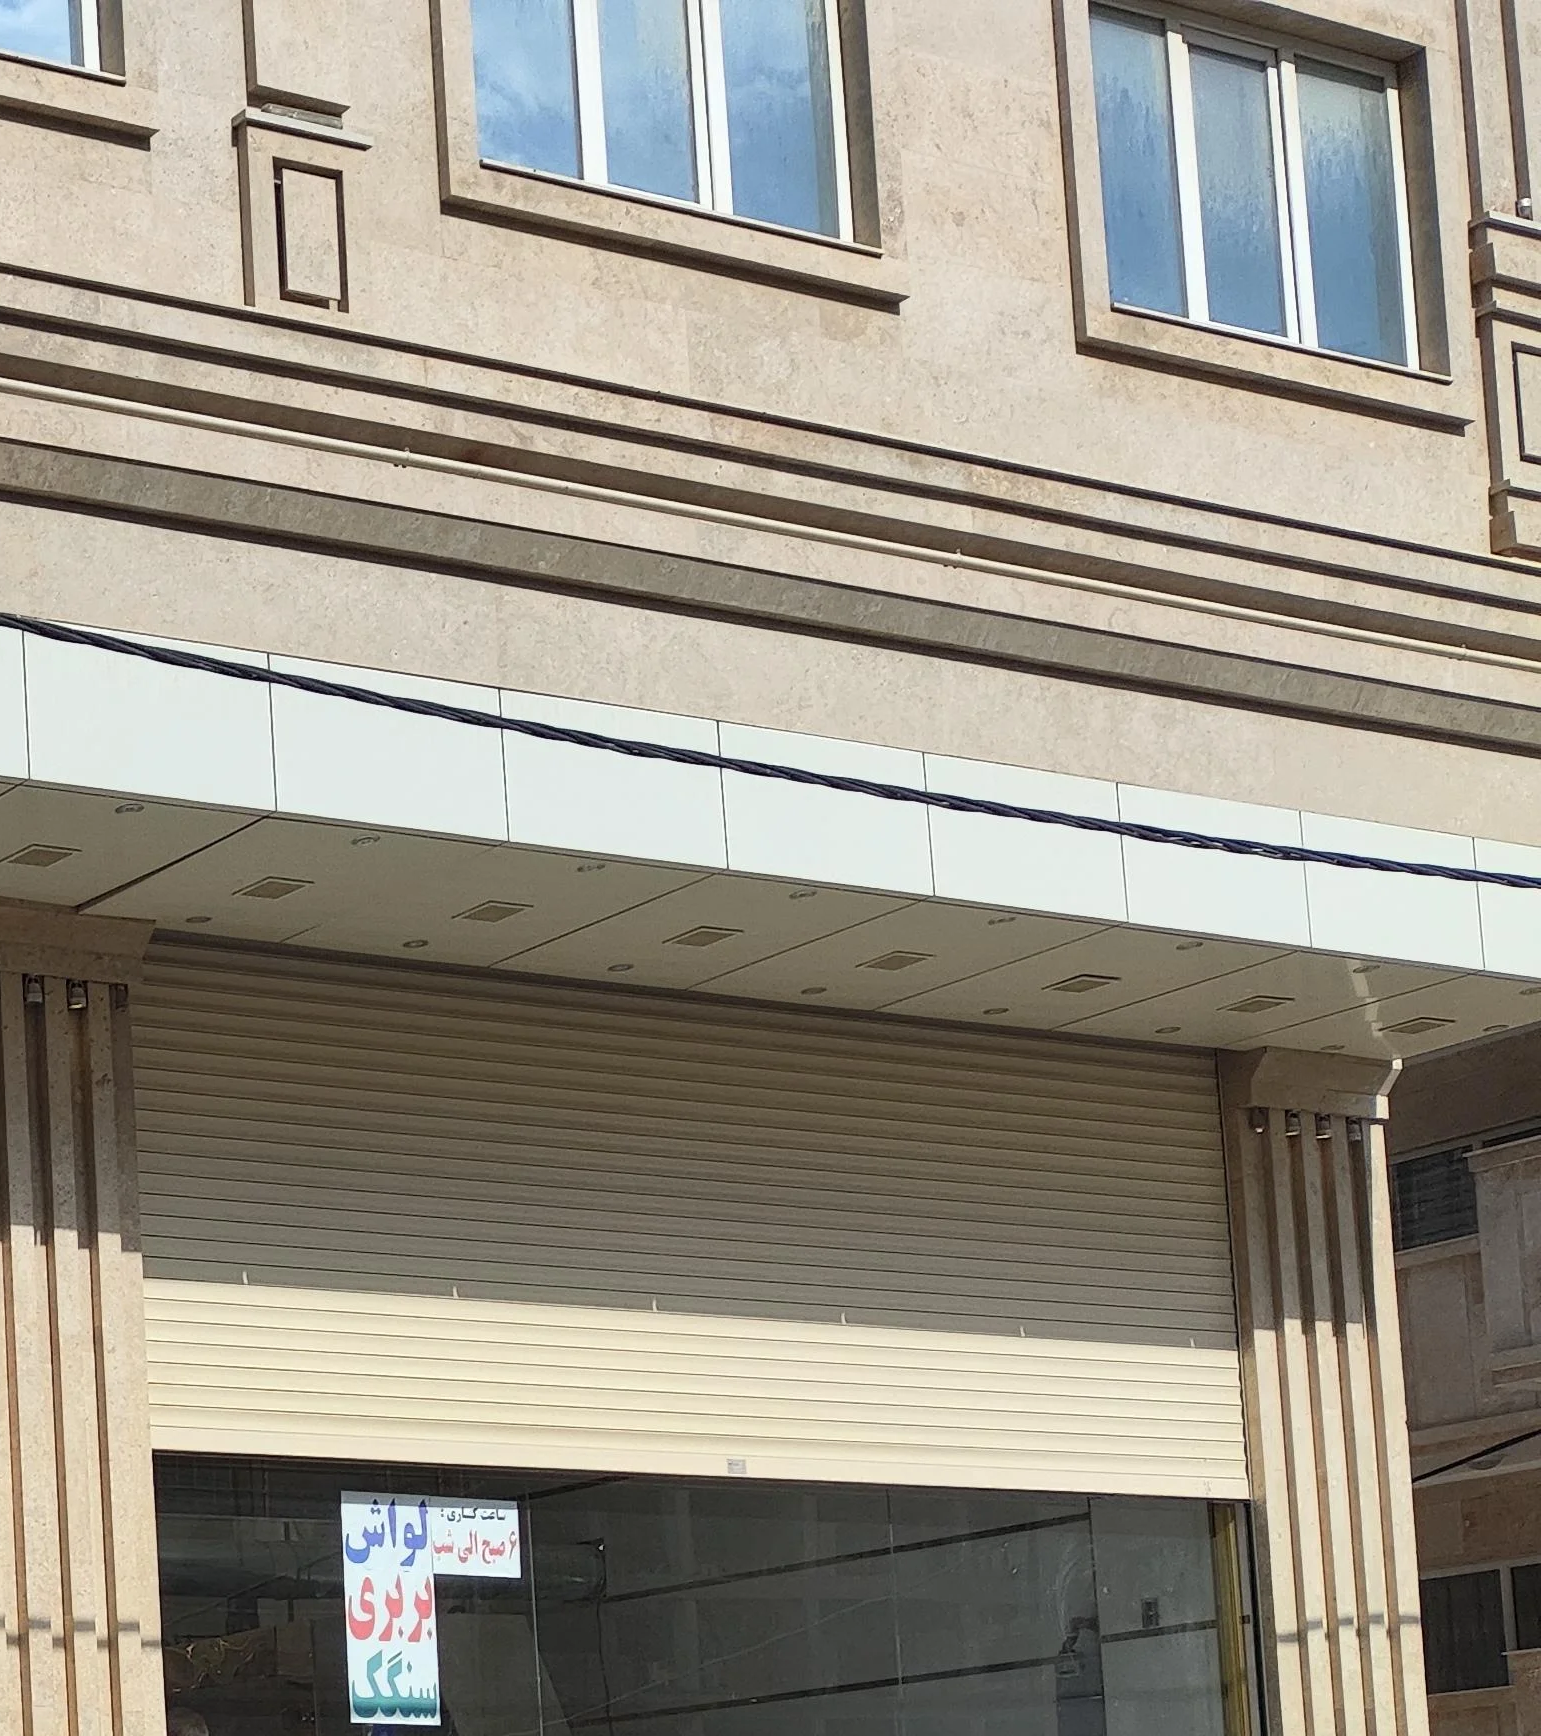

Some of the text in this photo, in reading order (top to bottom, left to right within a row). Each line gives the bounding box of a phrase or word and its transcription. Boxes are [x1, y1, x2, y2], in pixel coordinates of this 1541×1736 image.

[345, 1498, 429, 1567] لواش
[433, 1529, 518, 1565] ۶ صبح الی شب
[480, 1507, 506, 1521] ساعت
[348, 1574, 434, 1642] بربری
[352, 1650, 437, 1719] سنگک
